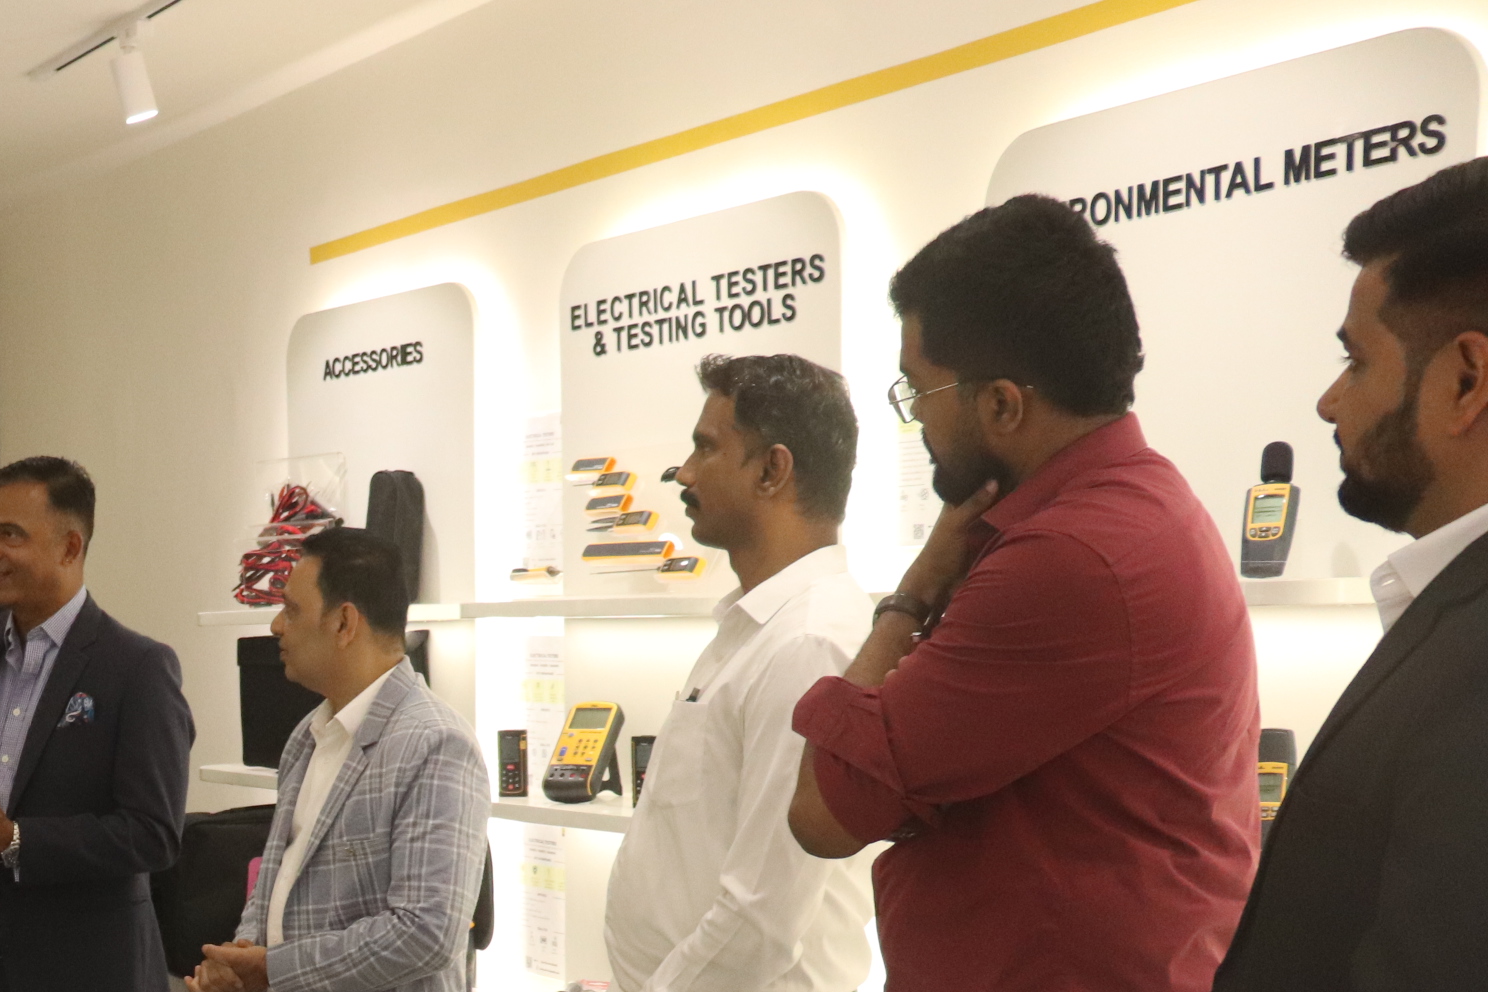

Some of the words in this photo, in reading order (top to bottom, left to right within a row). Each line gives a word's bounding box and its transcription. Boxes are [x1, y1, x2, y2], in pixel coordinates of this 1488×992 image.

[1283, 113, 1447, 186] METERS
[570, 279, 705, 331] ELECTRICAL
[711, 253, 826, 302] TESTERS
[592, 330, 608, 356] &
[613, 311, 707, 352] TESTING
[714, 292, 798, 334] TOOLS
[323, 341, 423, 381] ACCESSORIES
